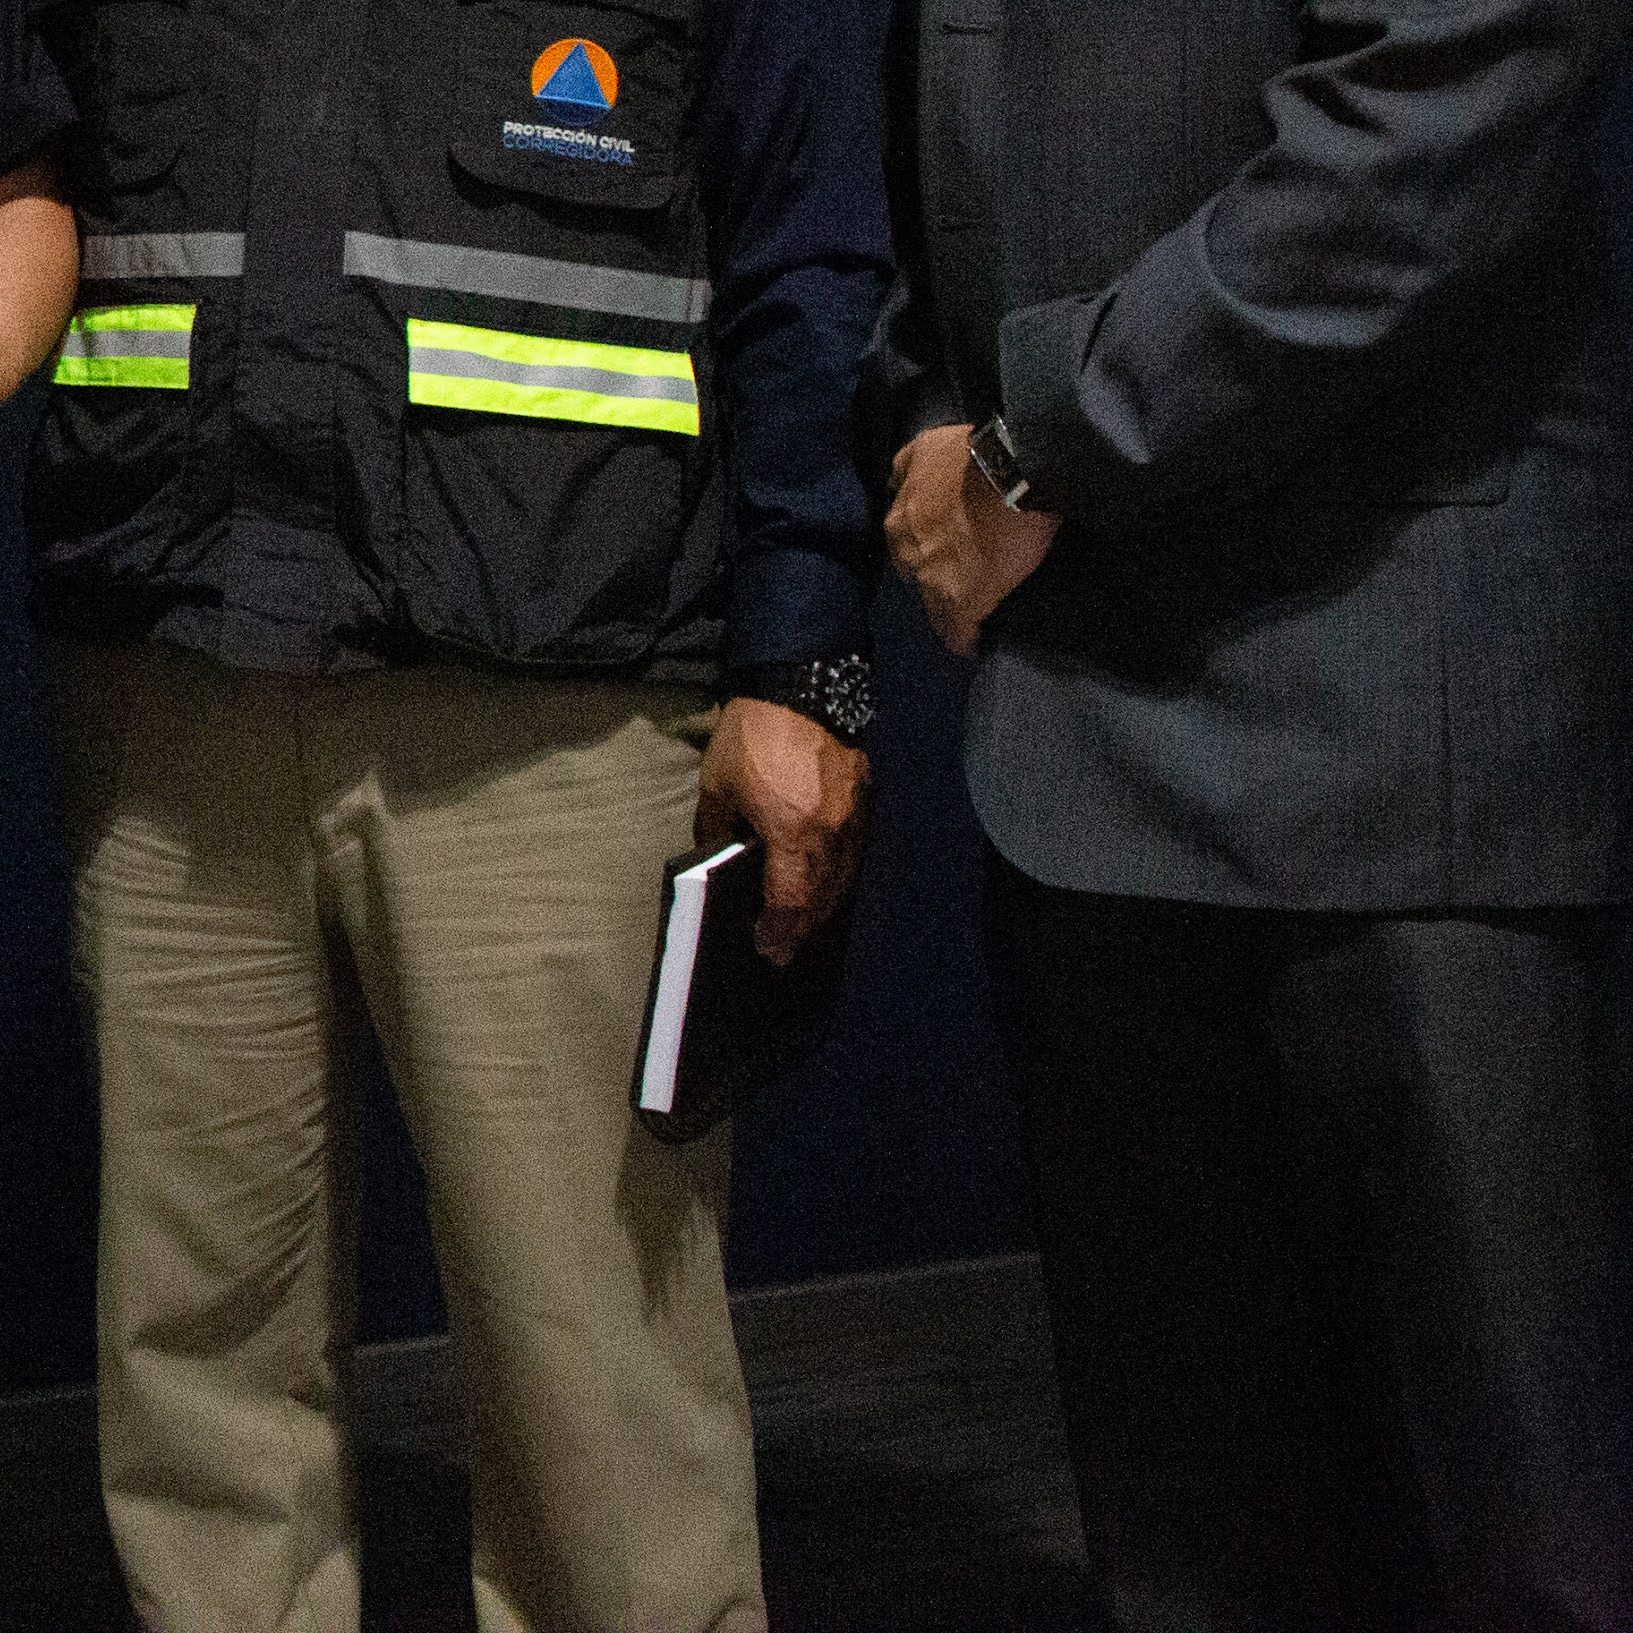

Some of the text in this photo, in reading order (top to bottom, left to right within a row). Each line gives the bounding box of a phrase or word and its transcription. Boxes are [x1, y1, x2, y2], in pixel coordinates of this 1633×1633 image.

[502, 133, 633, 166] CORREGIDORA
[503, 120, 634, 153] PROTECCIÓN CIVIL
